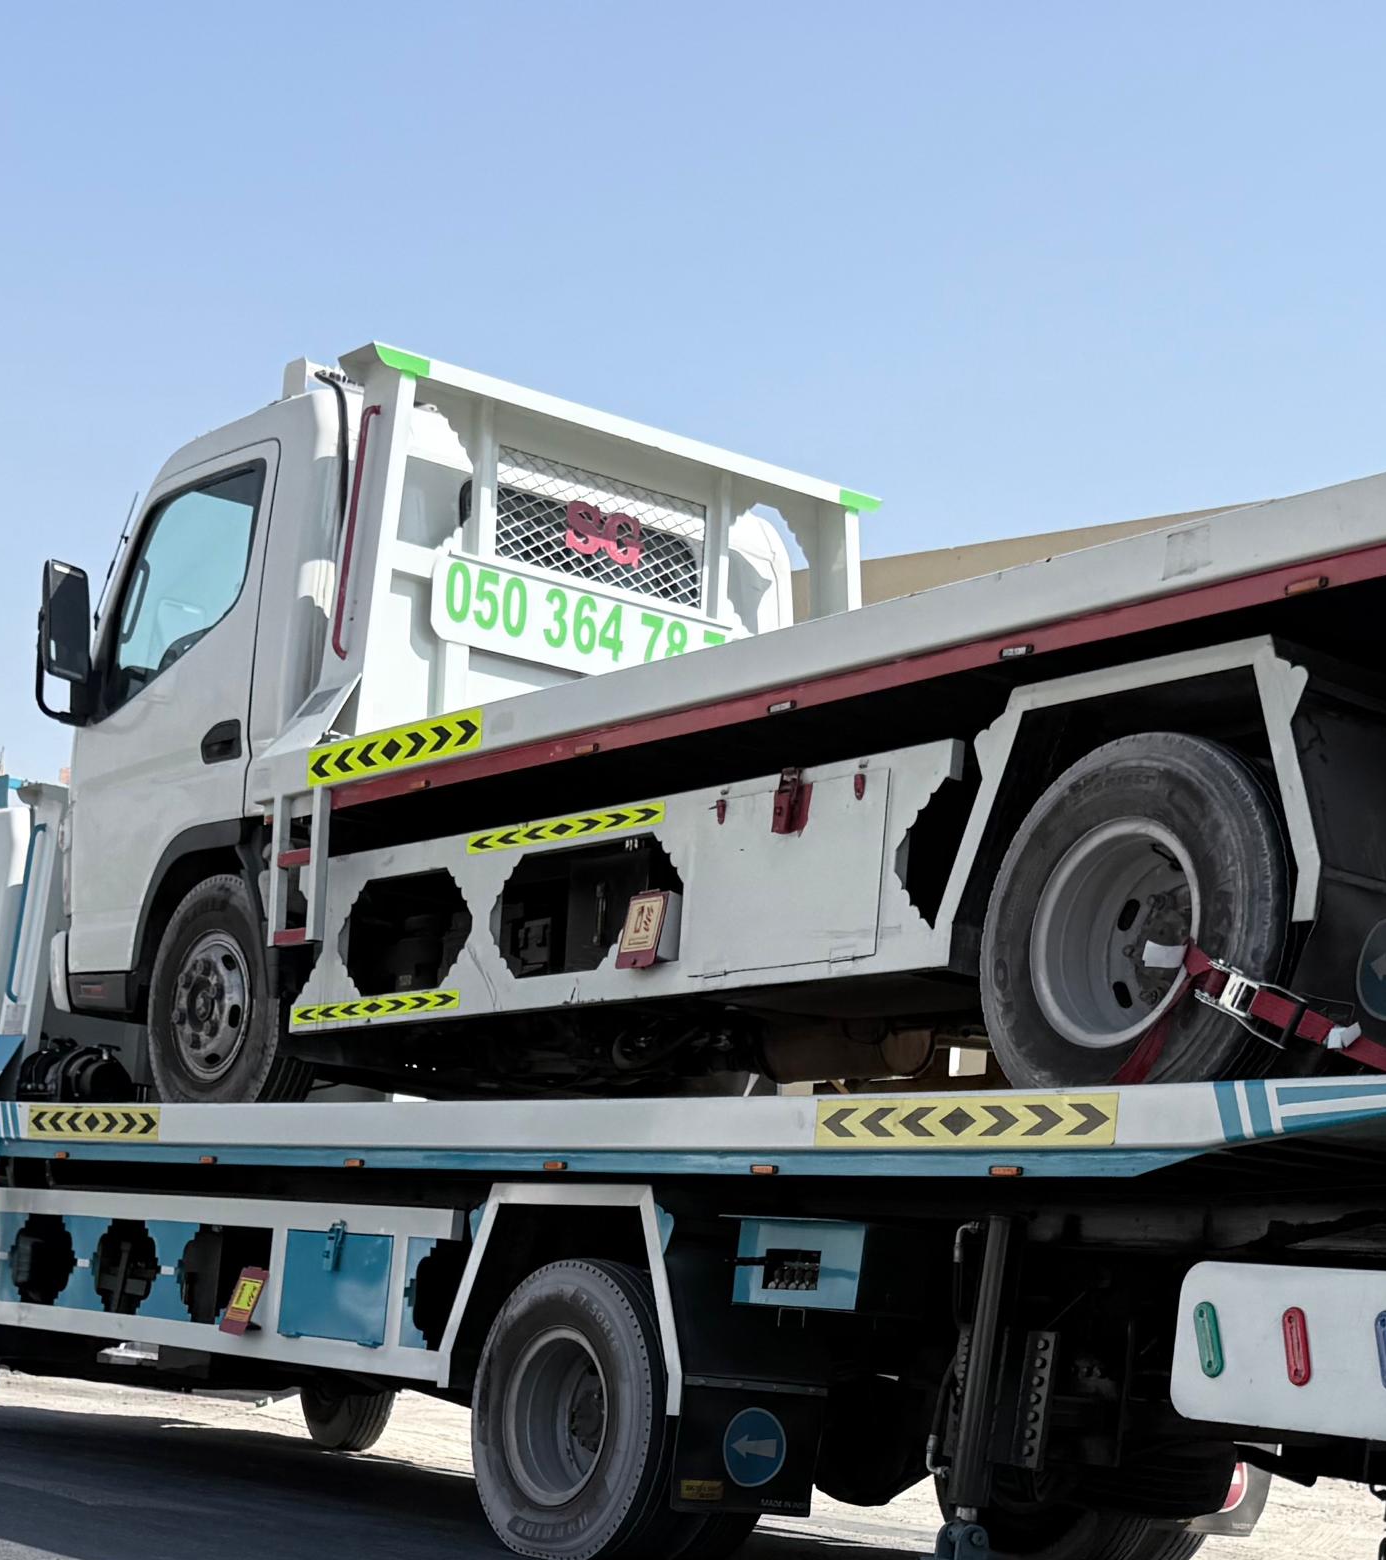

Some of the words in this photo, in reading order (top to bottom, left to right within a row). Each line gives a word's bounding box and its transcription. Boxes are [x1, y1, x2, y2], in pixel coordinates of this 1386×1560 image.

[565, 499, 644, 569] SG
[445, 561, 528, 638] 050
[543, 588, 624, 662] 364
